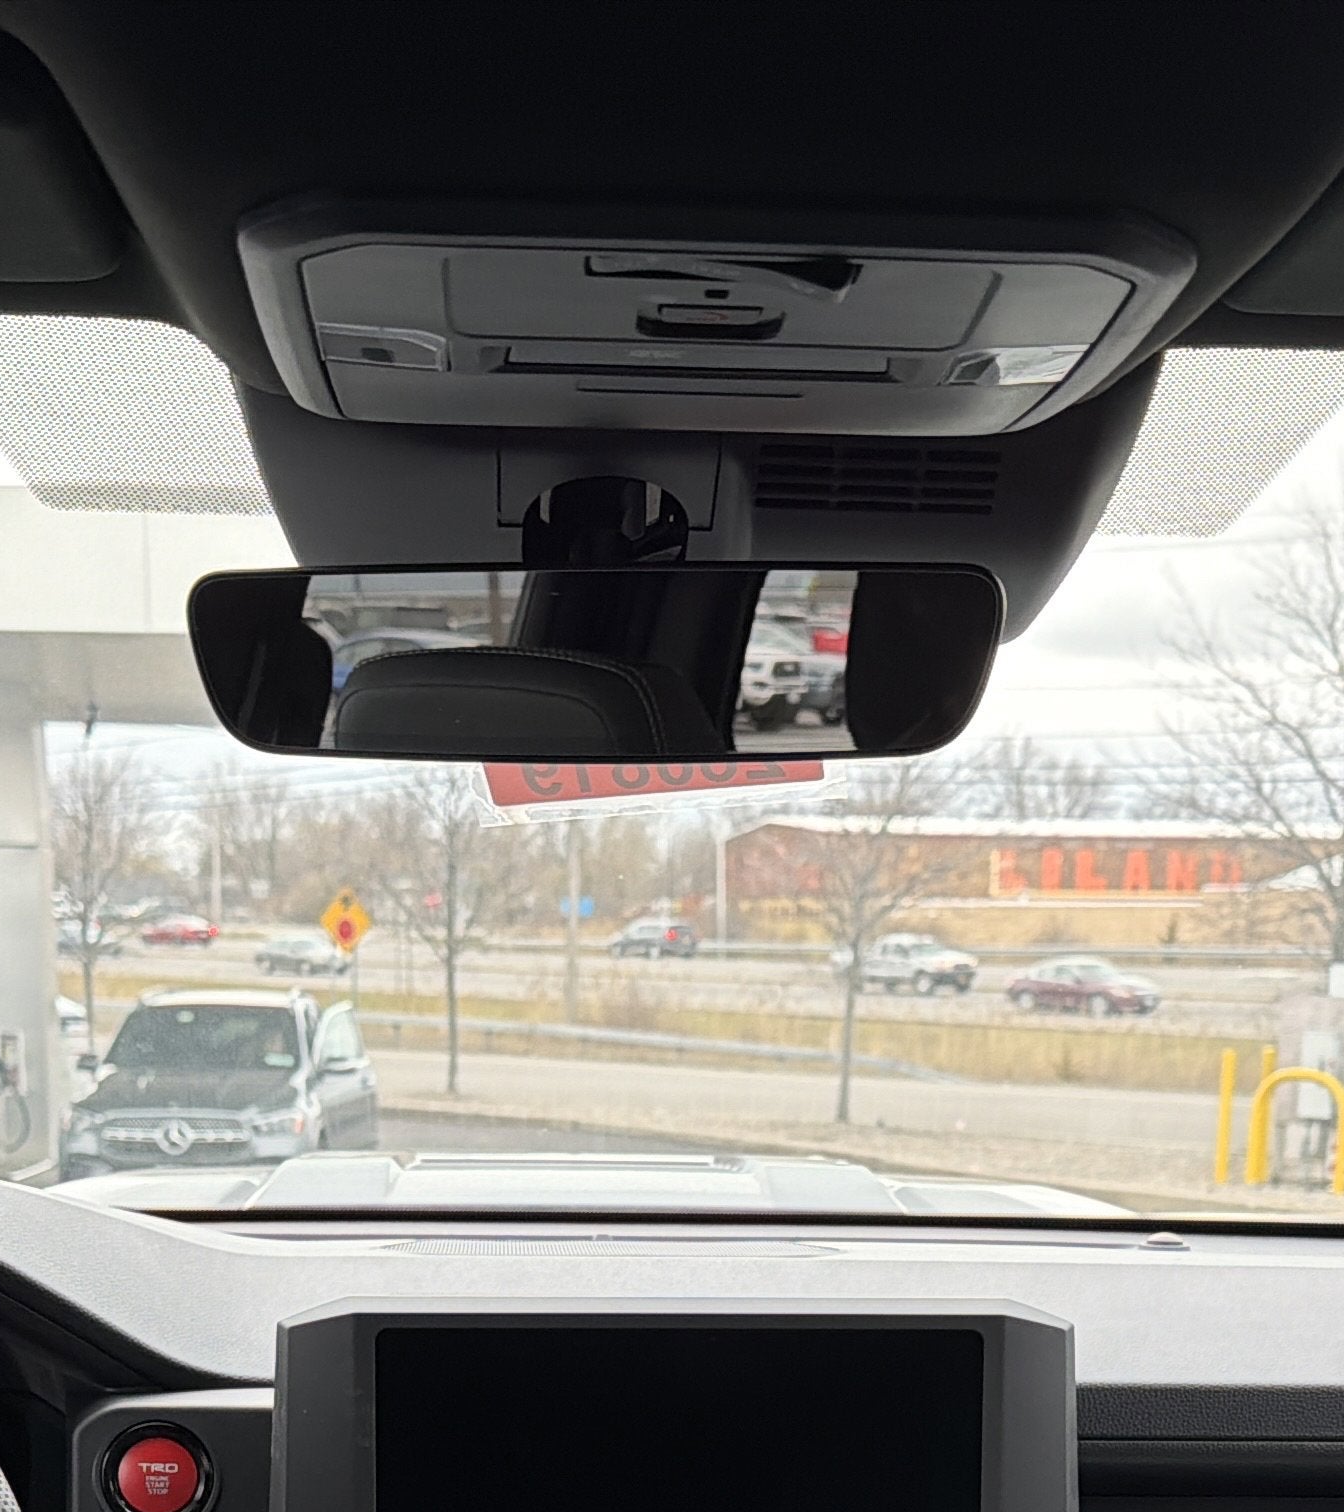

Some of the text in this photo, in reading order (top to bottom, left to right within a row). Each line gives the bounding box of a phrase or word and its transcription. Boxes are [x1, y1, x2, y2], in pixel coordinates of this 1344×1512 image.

[137, 1462, 179, 1474] TRD
[145, 1481, 170, 1489] START
[147, 1488, 169, 1496] STOP
